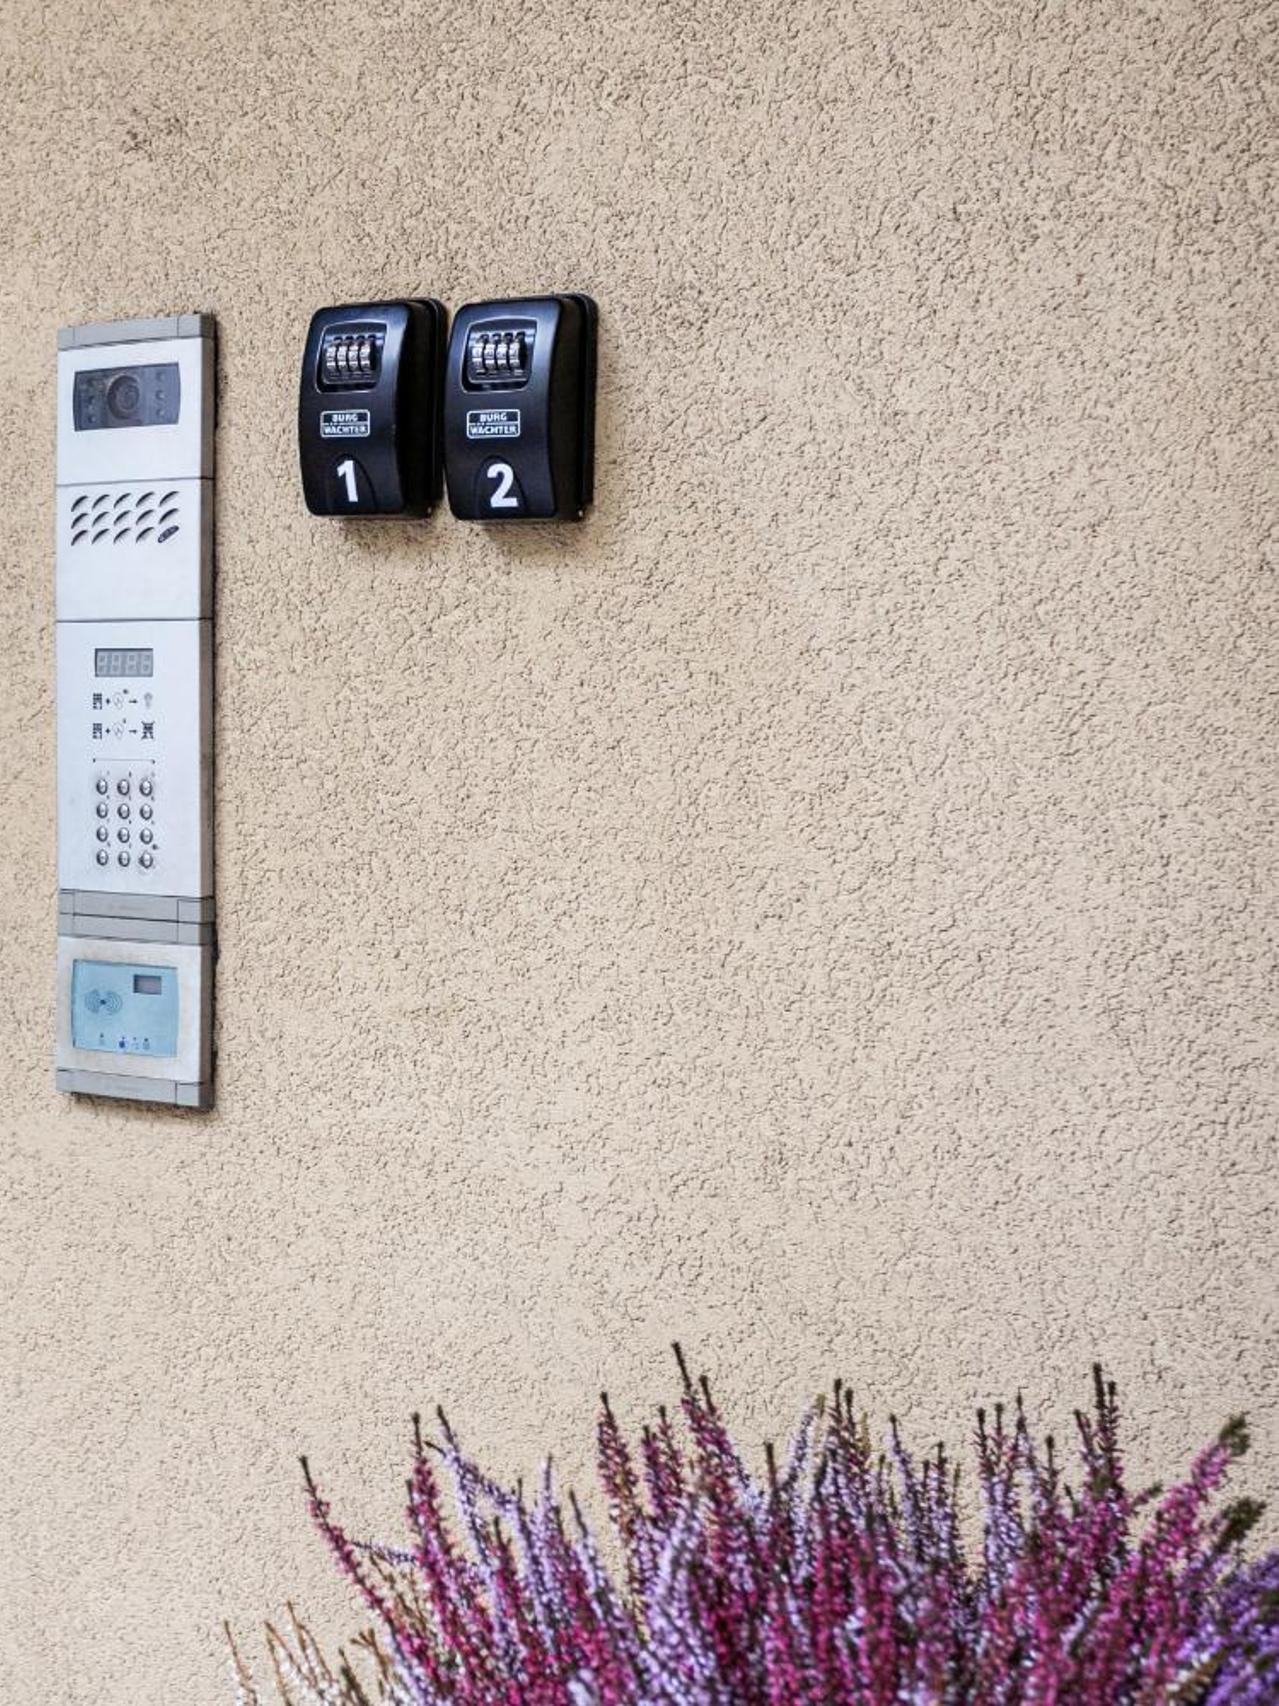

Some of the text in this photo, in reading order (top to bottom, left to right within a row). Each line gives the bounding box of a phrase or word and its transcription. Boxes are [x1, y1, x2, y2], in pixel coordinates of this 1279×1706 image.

[332, 413, 358, 422] BURG
[480, 412, 507, 422] BURG
[337, 460, 358, 503] 1
[486, 463, 519, 509] 2
